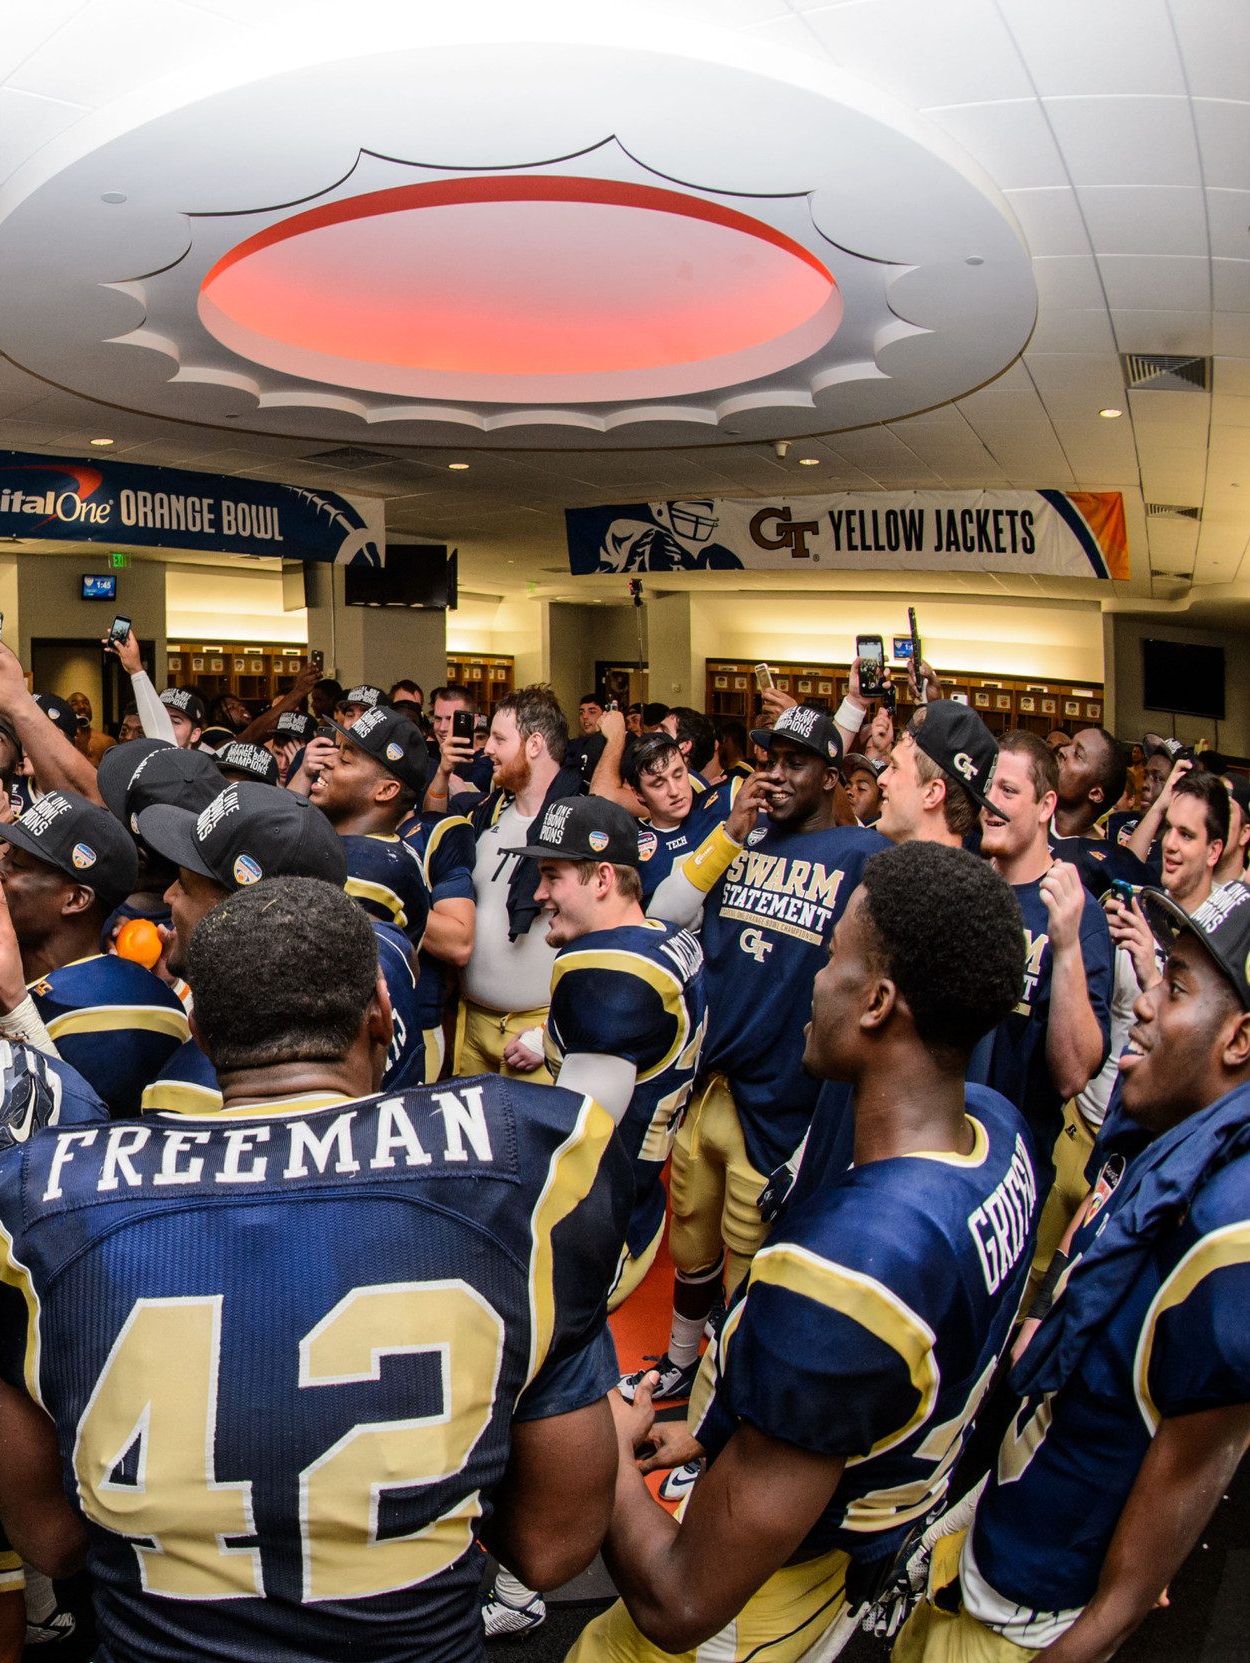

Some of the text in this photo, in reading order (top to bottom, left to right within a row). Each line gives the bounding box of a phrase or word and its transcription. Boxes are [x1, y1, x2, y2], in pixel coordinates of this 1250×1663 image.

[120, 489, 216, 534] ORANGE
[221, 500, 284, 541] BOWL
[750, 506, 1036, 558] GT YELLOW JACKETS
[225, 756, 269, 776] CHAMPIONS
[51, 796, 73, 815] ONE
[666, 836, 688, 850] TECH
[726, 849, 845, 909] SWARM
[722, 883, 832, 932] STATEMENT
[780, 921, 814, 941] CHAMPIONS
[43, 1086, 495, 1202] FREEMAN
[72, 1279, 507, 1602] 42
